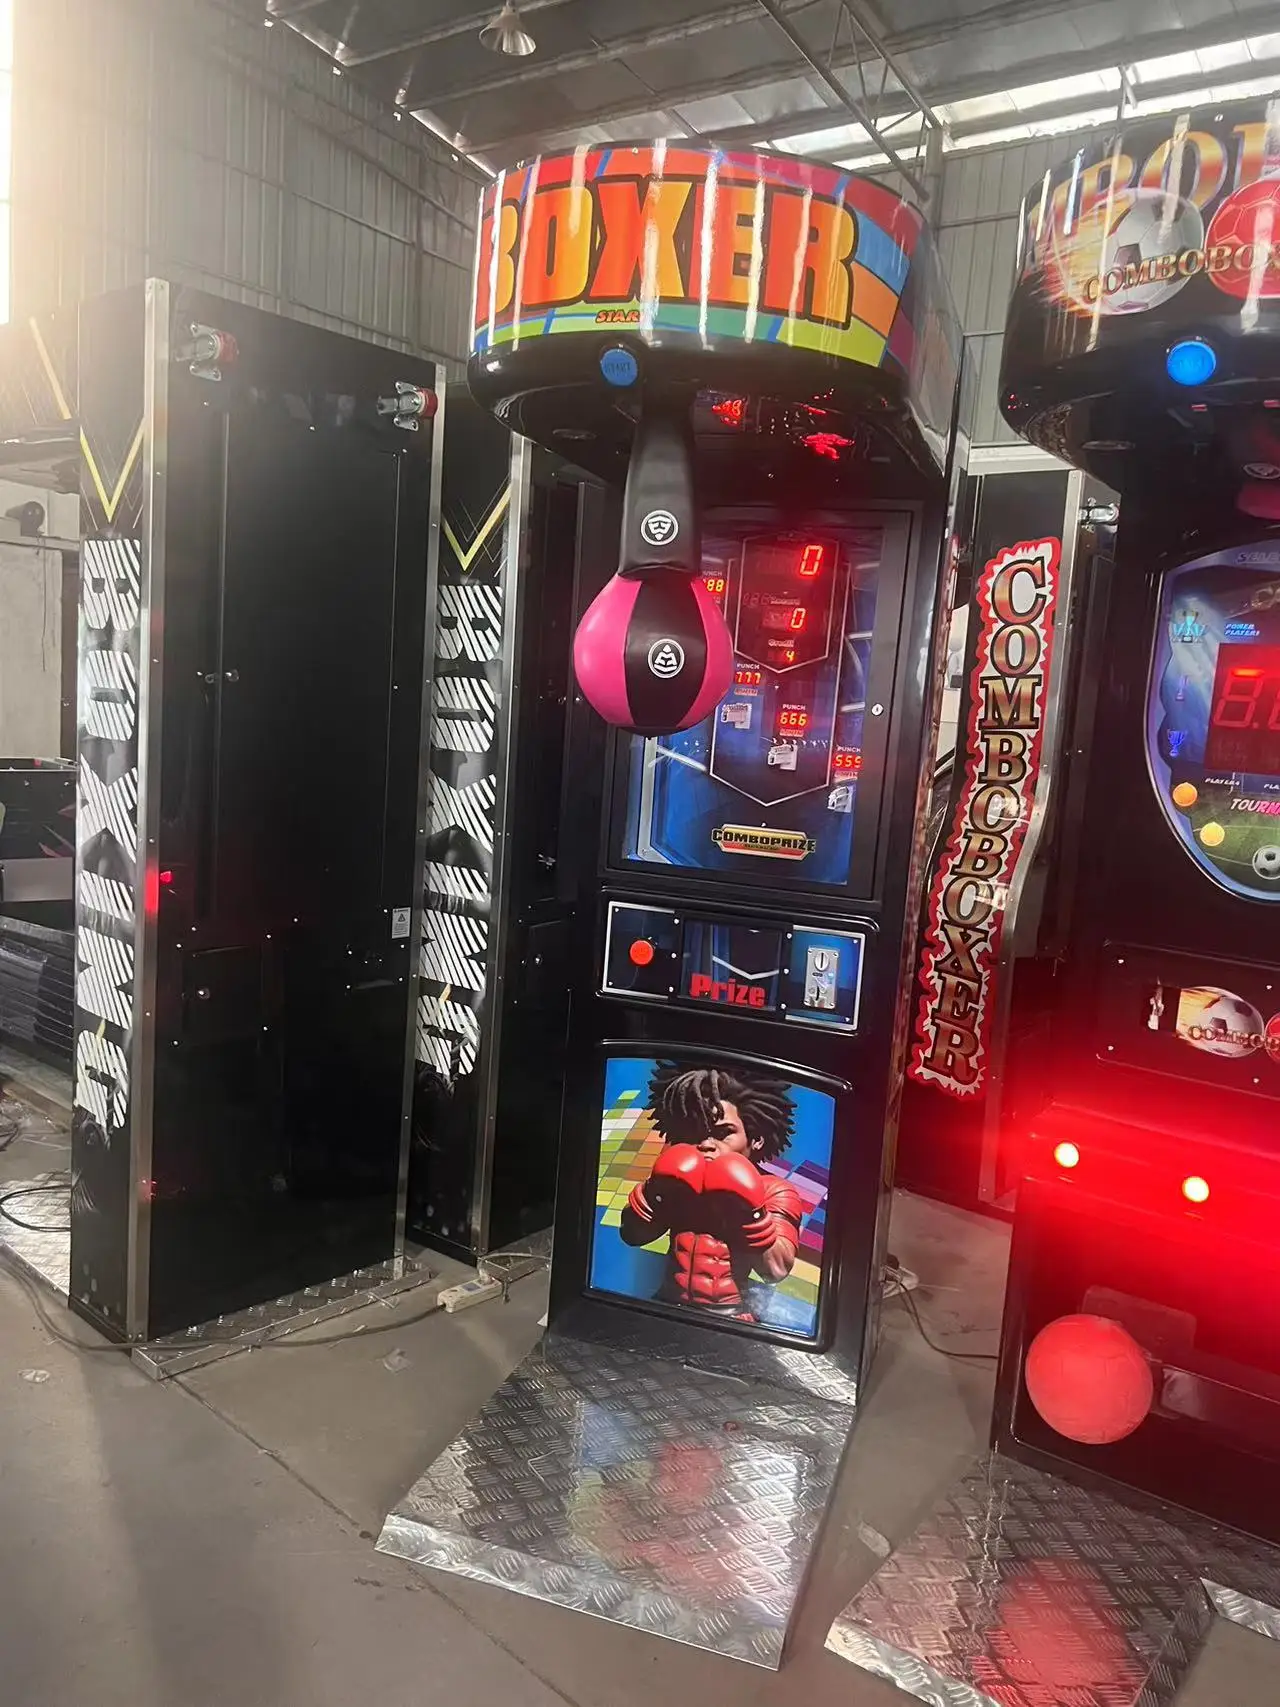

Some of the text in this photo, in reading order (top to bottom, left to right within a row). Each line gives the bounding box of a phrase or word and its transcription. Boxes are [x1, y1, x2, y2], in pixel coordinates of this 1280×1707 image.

[476, 175, 858, 329] BOXER
[800, 545, 823, 575] 0
[790, 608, 806, 629] 0
[786, 650, 795, 662] 4
[736, 662, 760, 670] PUNCH
[735, 671, 761, 685] 777
[782, 703, 806, 711] PUNCH
[780, 712, 808, 726] 666
[835, 754, 862, 768] 555
[922, 556, 1048, 1086] COMBOBOXER
[711, 828, 818, 853] COMBOPRIZE
[690, 973, 767, 1008] Prize
